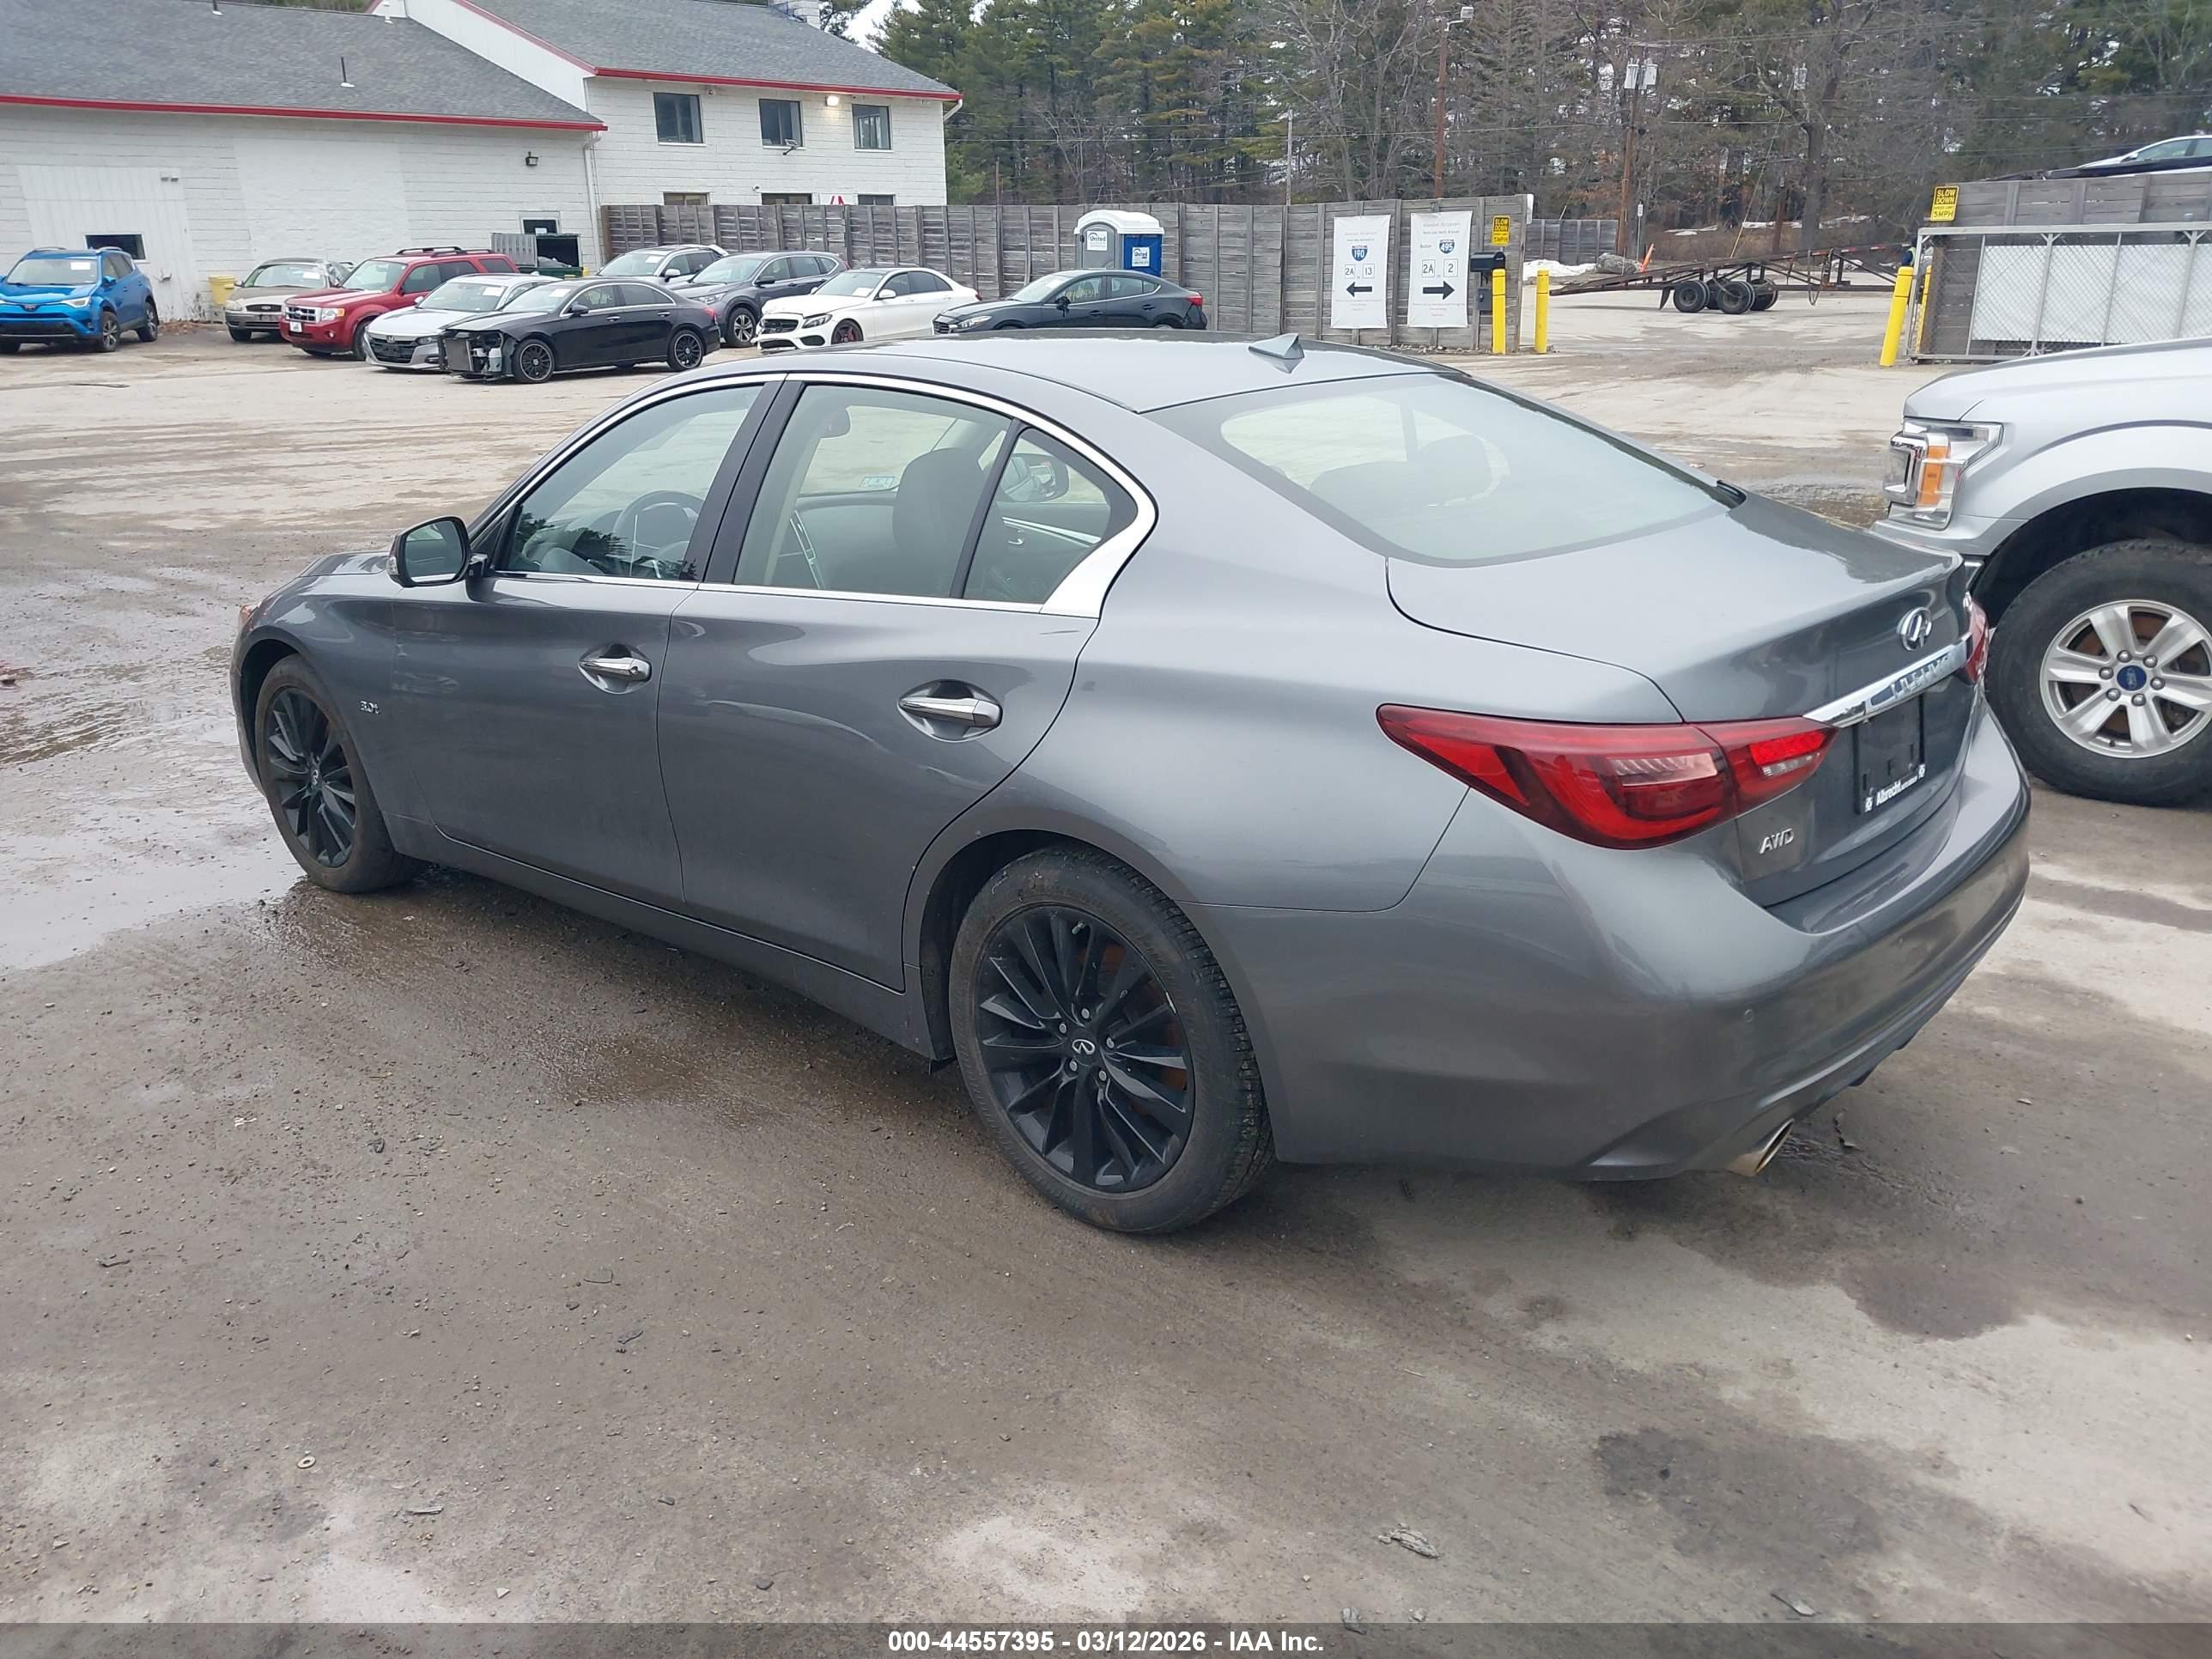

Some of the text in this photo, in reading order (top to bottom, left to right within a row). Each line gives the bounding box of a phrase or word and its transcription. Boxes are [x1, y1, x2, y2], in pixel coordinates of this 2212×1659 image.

[1441, 242, 1453, 252] 495
[1354, 249, 1365, 258] 190
[1345, 267, 1354, 276] 2A
[1364, 267, 1372, 276] 13
[1423, 264, 1434, 274] 2A
[1448, 263, 1454, 273] 2
[1759, 827, 1795, 854] AWD
